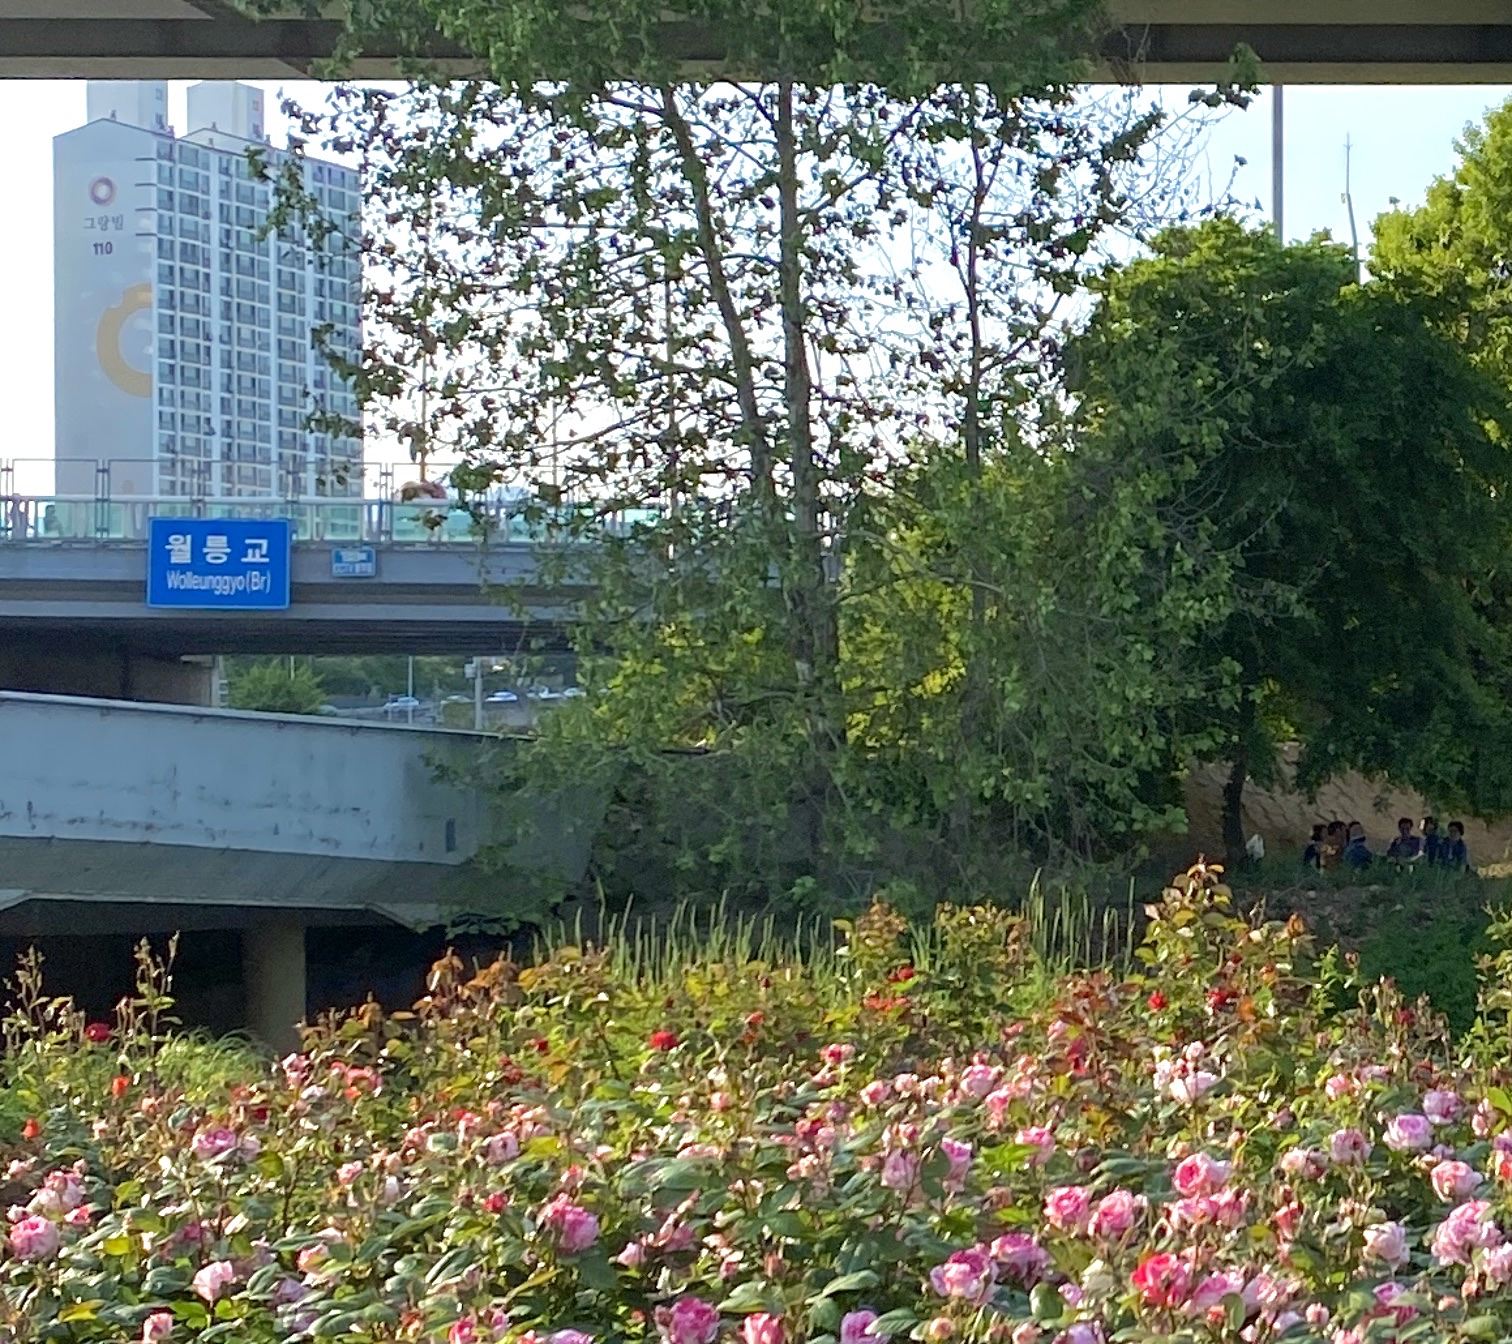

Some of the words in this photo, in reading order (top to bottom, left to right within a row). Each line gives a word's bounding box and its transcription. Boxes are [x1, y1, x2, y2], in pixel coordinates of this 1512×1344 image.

[93, 241, 113, 256] 110
[165, 534, 270, 564] 월릉교
[166, 569, 271, 595] Wolleunggyo(Br)
